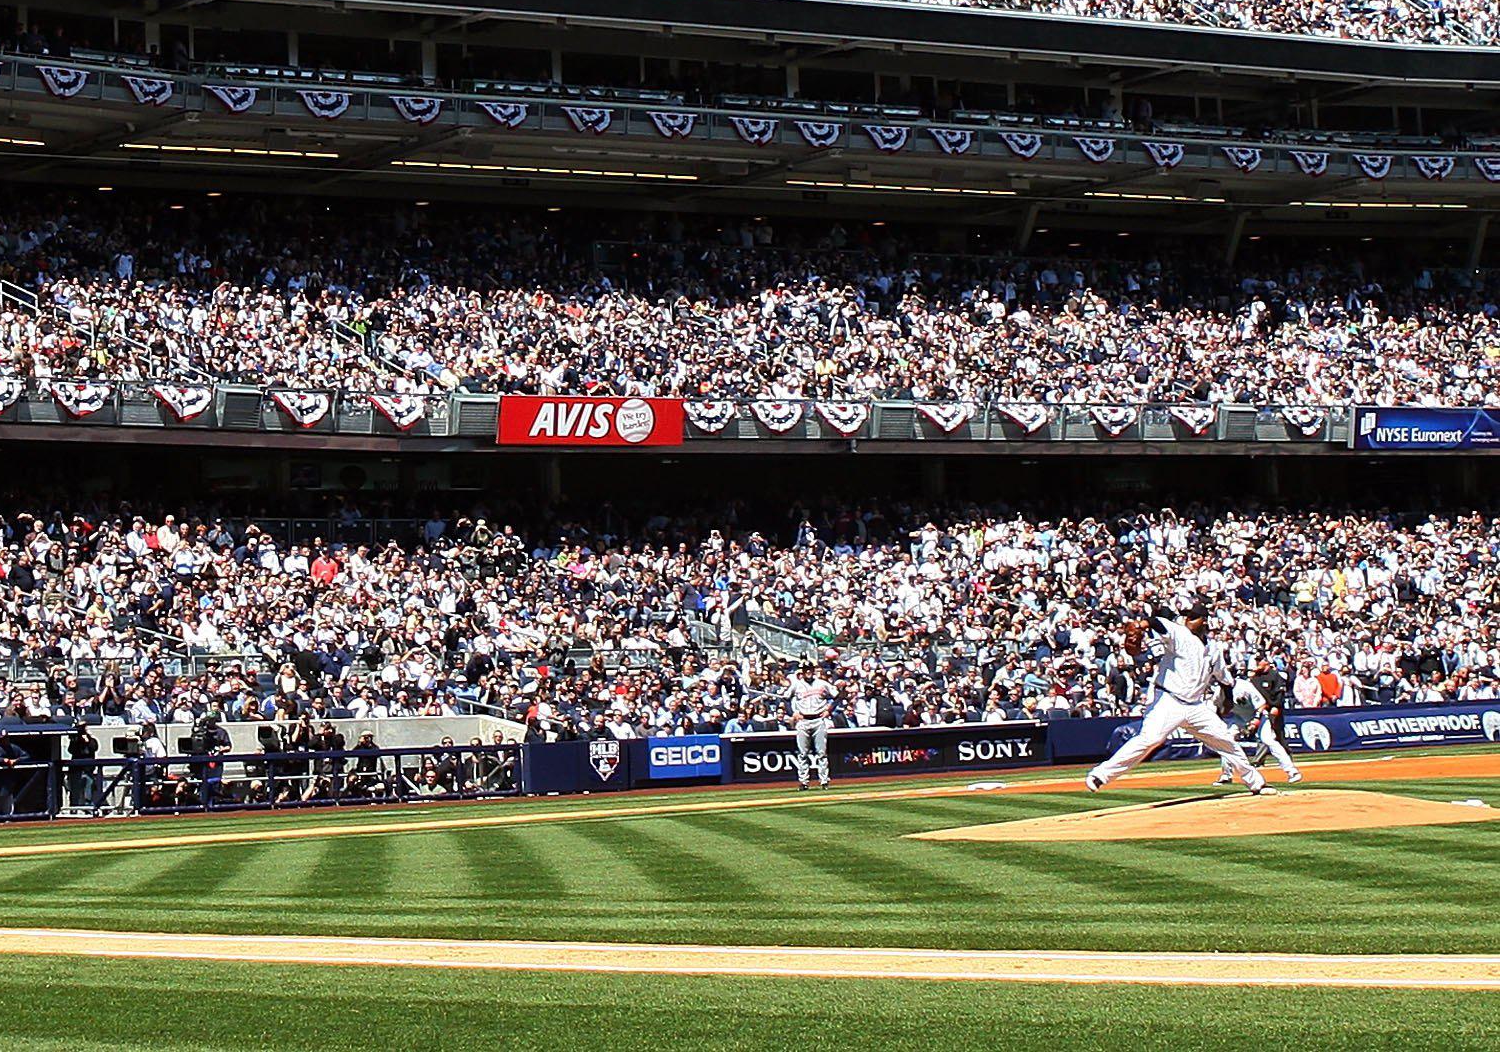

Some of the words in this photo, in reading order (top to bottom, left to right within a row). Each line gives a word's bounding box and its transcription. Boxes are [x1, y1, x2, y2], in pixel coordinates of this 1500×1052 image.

[528, 402, 615, 438] AVIS
[1376, 427, 1409, 443] NYSE
[1411, 427, 1463, 443] Euronext
[651, 744, 720, 766] GEICO
